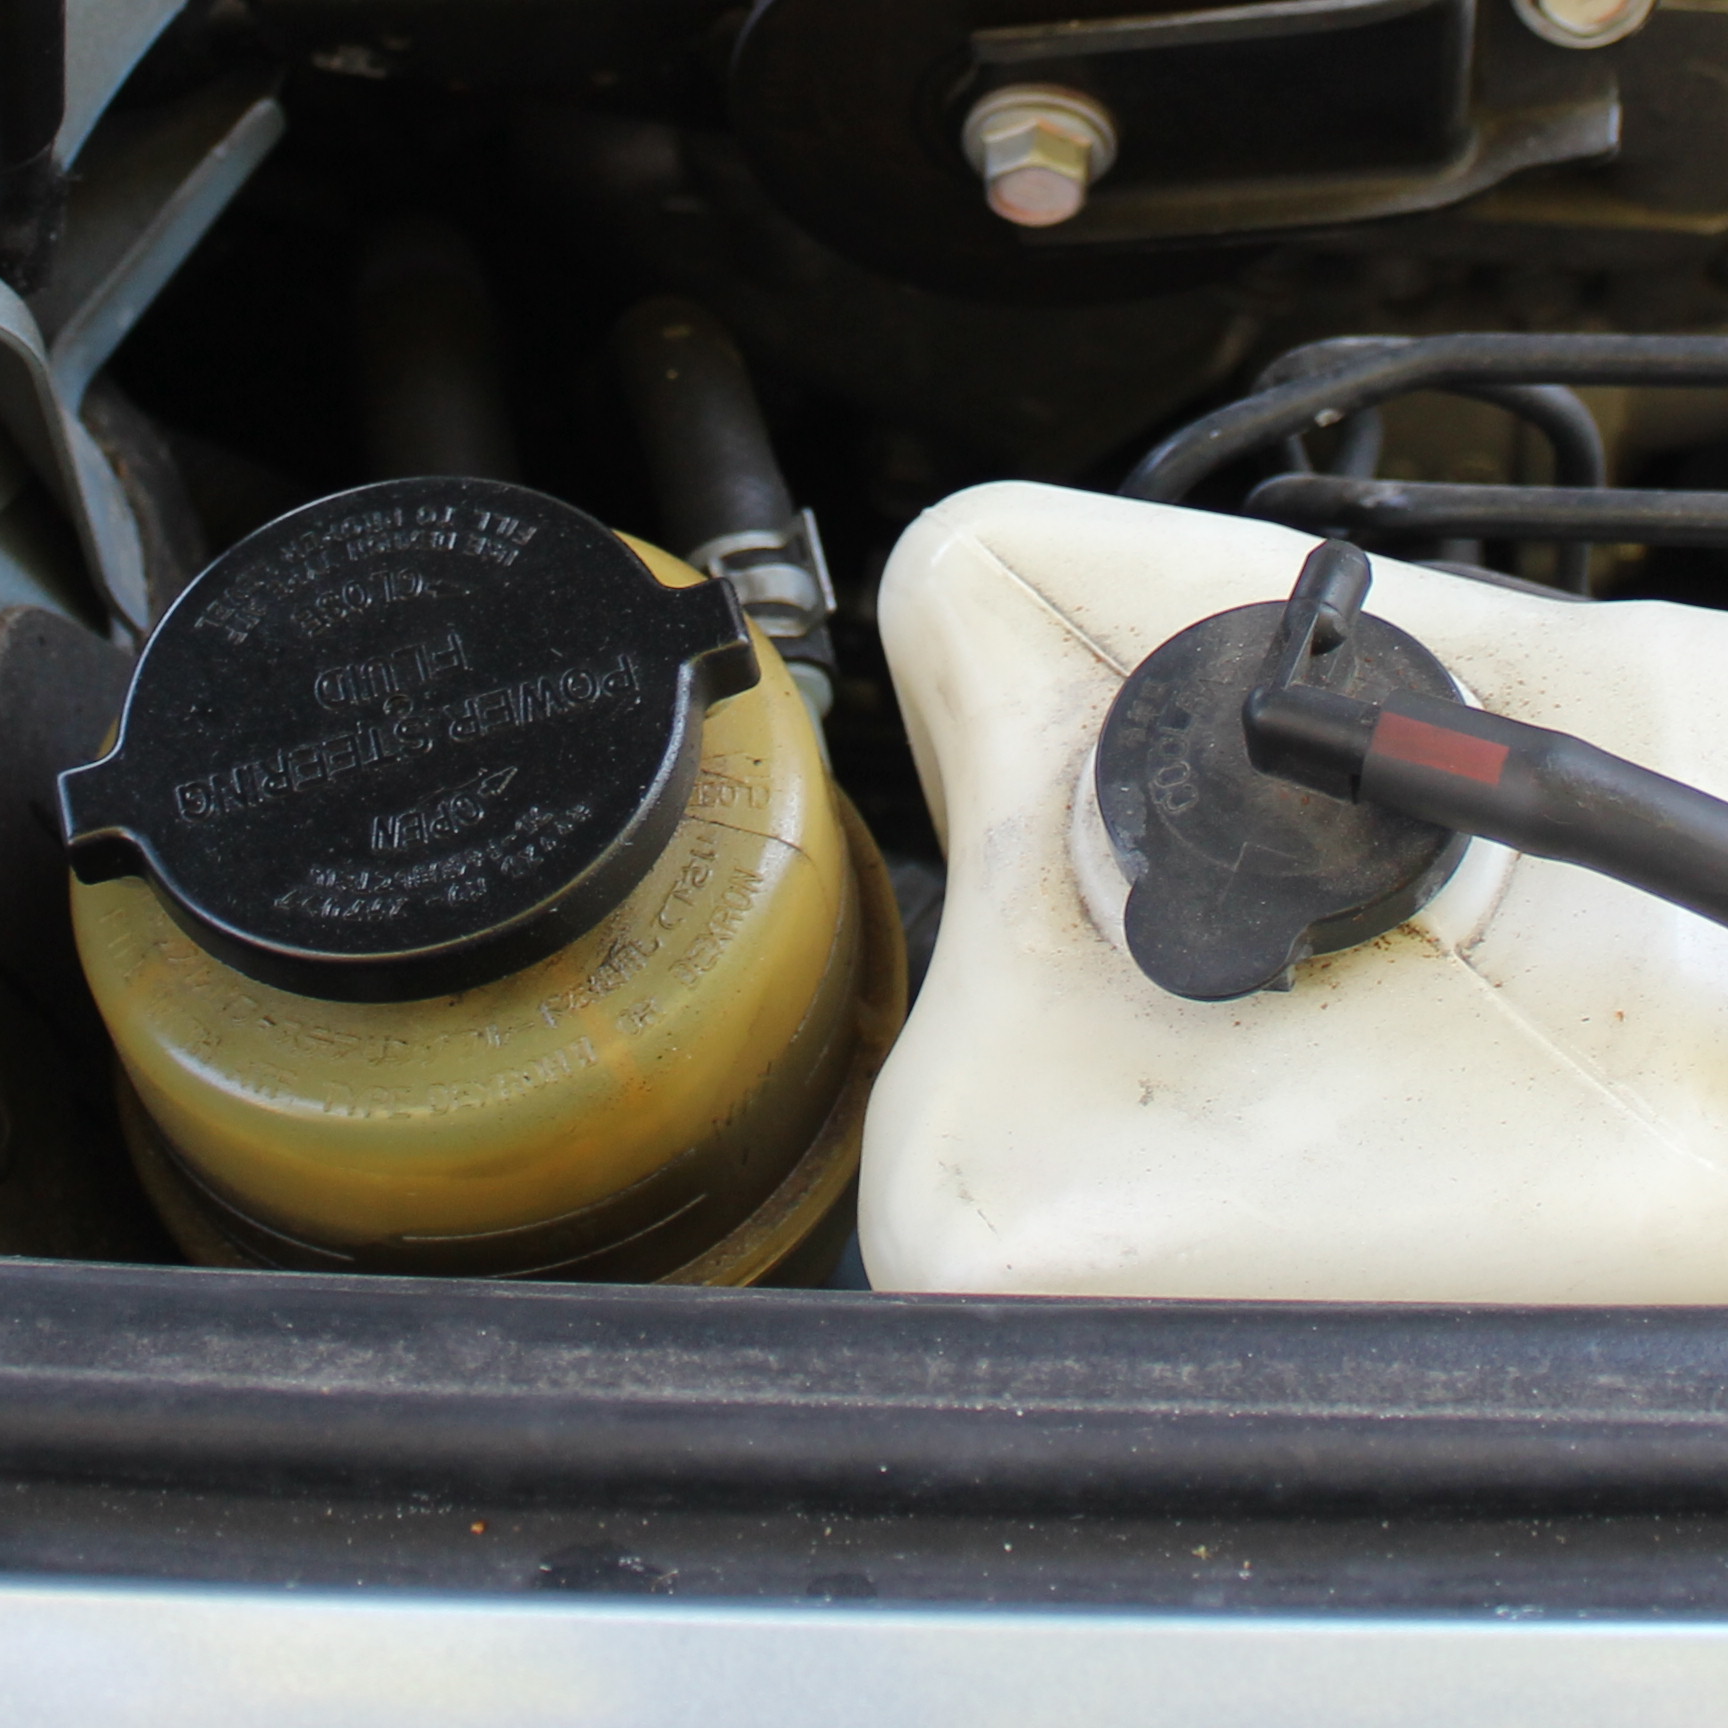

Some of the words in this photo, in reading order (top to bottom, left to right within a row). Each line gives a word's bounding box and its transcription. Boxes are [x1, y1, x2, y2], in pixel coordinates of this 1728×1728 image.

[298, 567, 430, 637] CLOSE
[316, 633, 470, 710] FLUID
[450, 654, 641, 742] POWER
[175, 716, 436, 823] STEERING
[371, 792, 487, 852] OPEN
